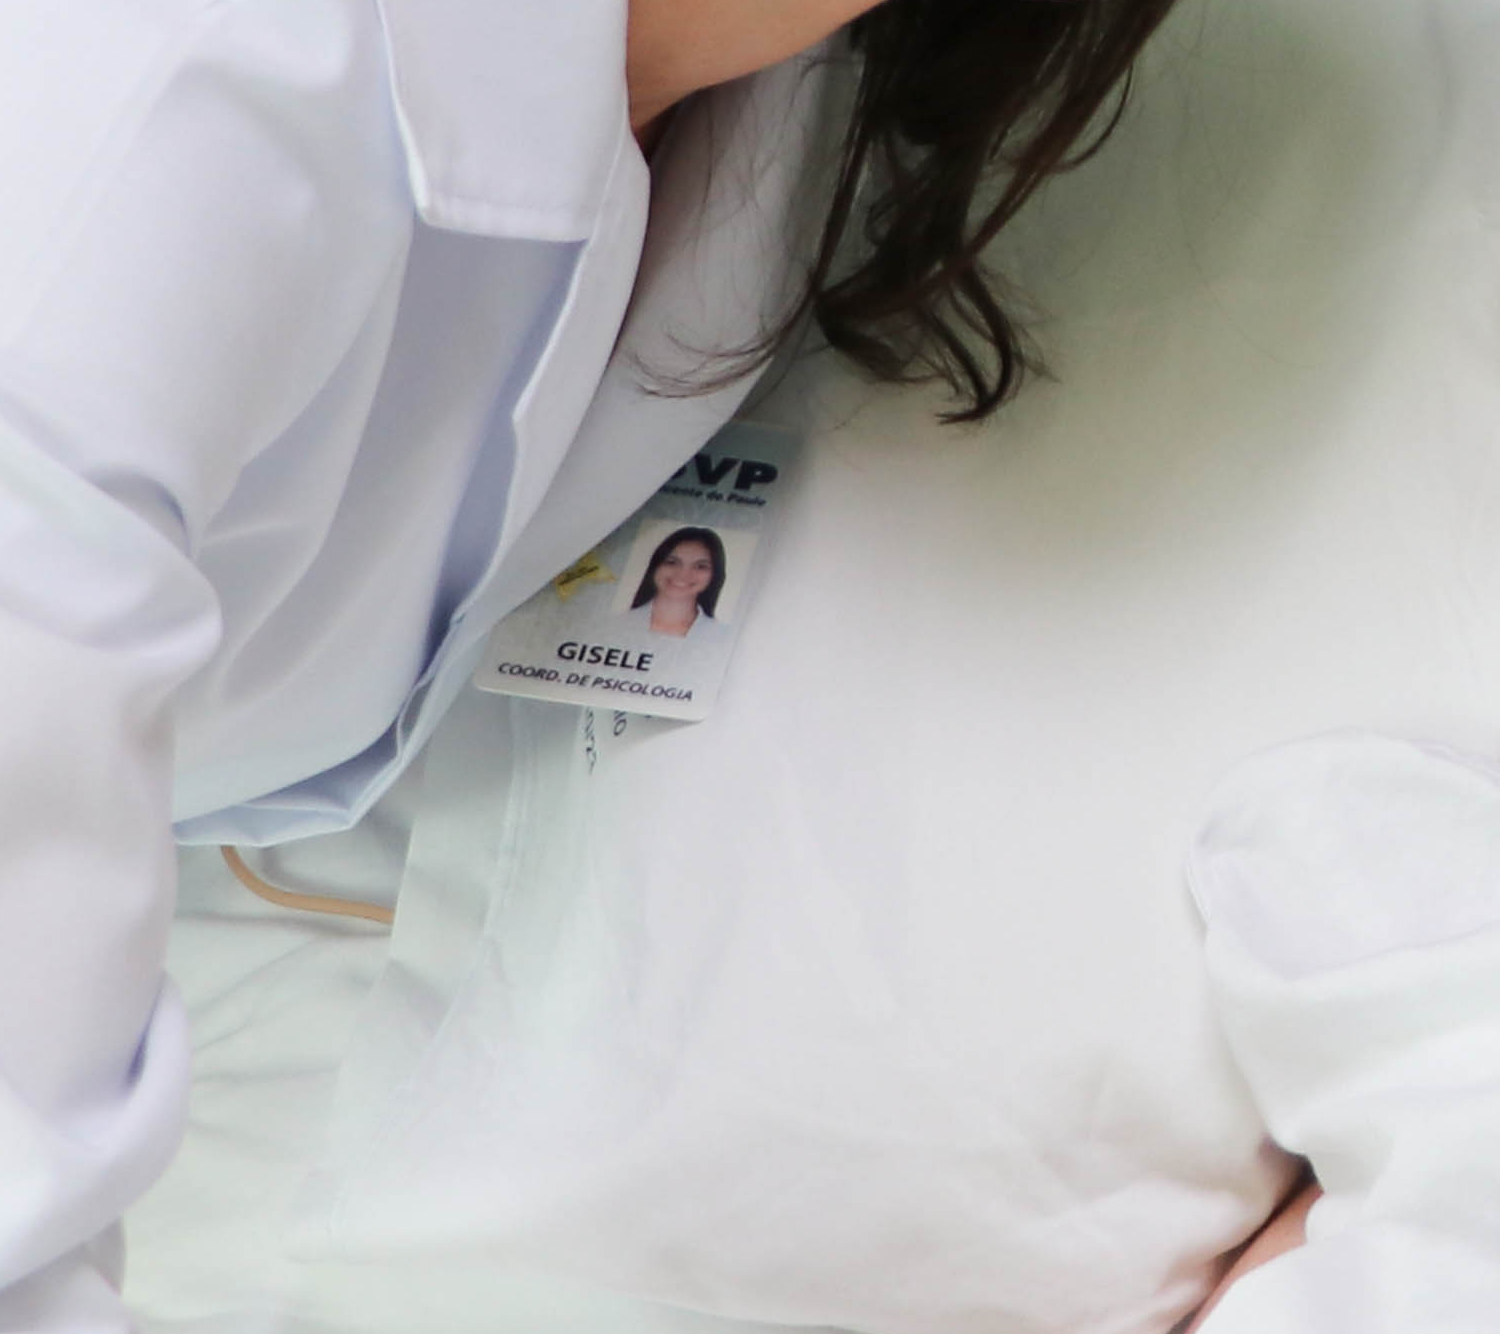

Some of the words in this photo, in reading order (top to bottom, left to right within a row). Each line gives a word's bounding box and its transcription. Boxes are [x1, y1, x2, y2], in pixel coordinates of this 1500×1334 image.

[670, 451, 778, 490] VP
[557, 641, 654, 672] GISELE
[498, 661, 561, 684] COORD.
[566, 672, 590, 687] DE
[592, 677, 693, 702] PSICOLOGIA
